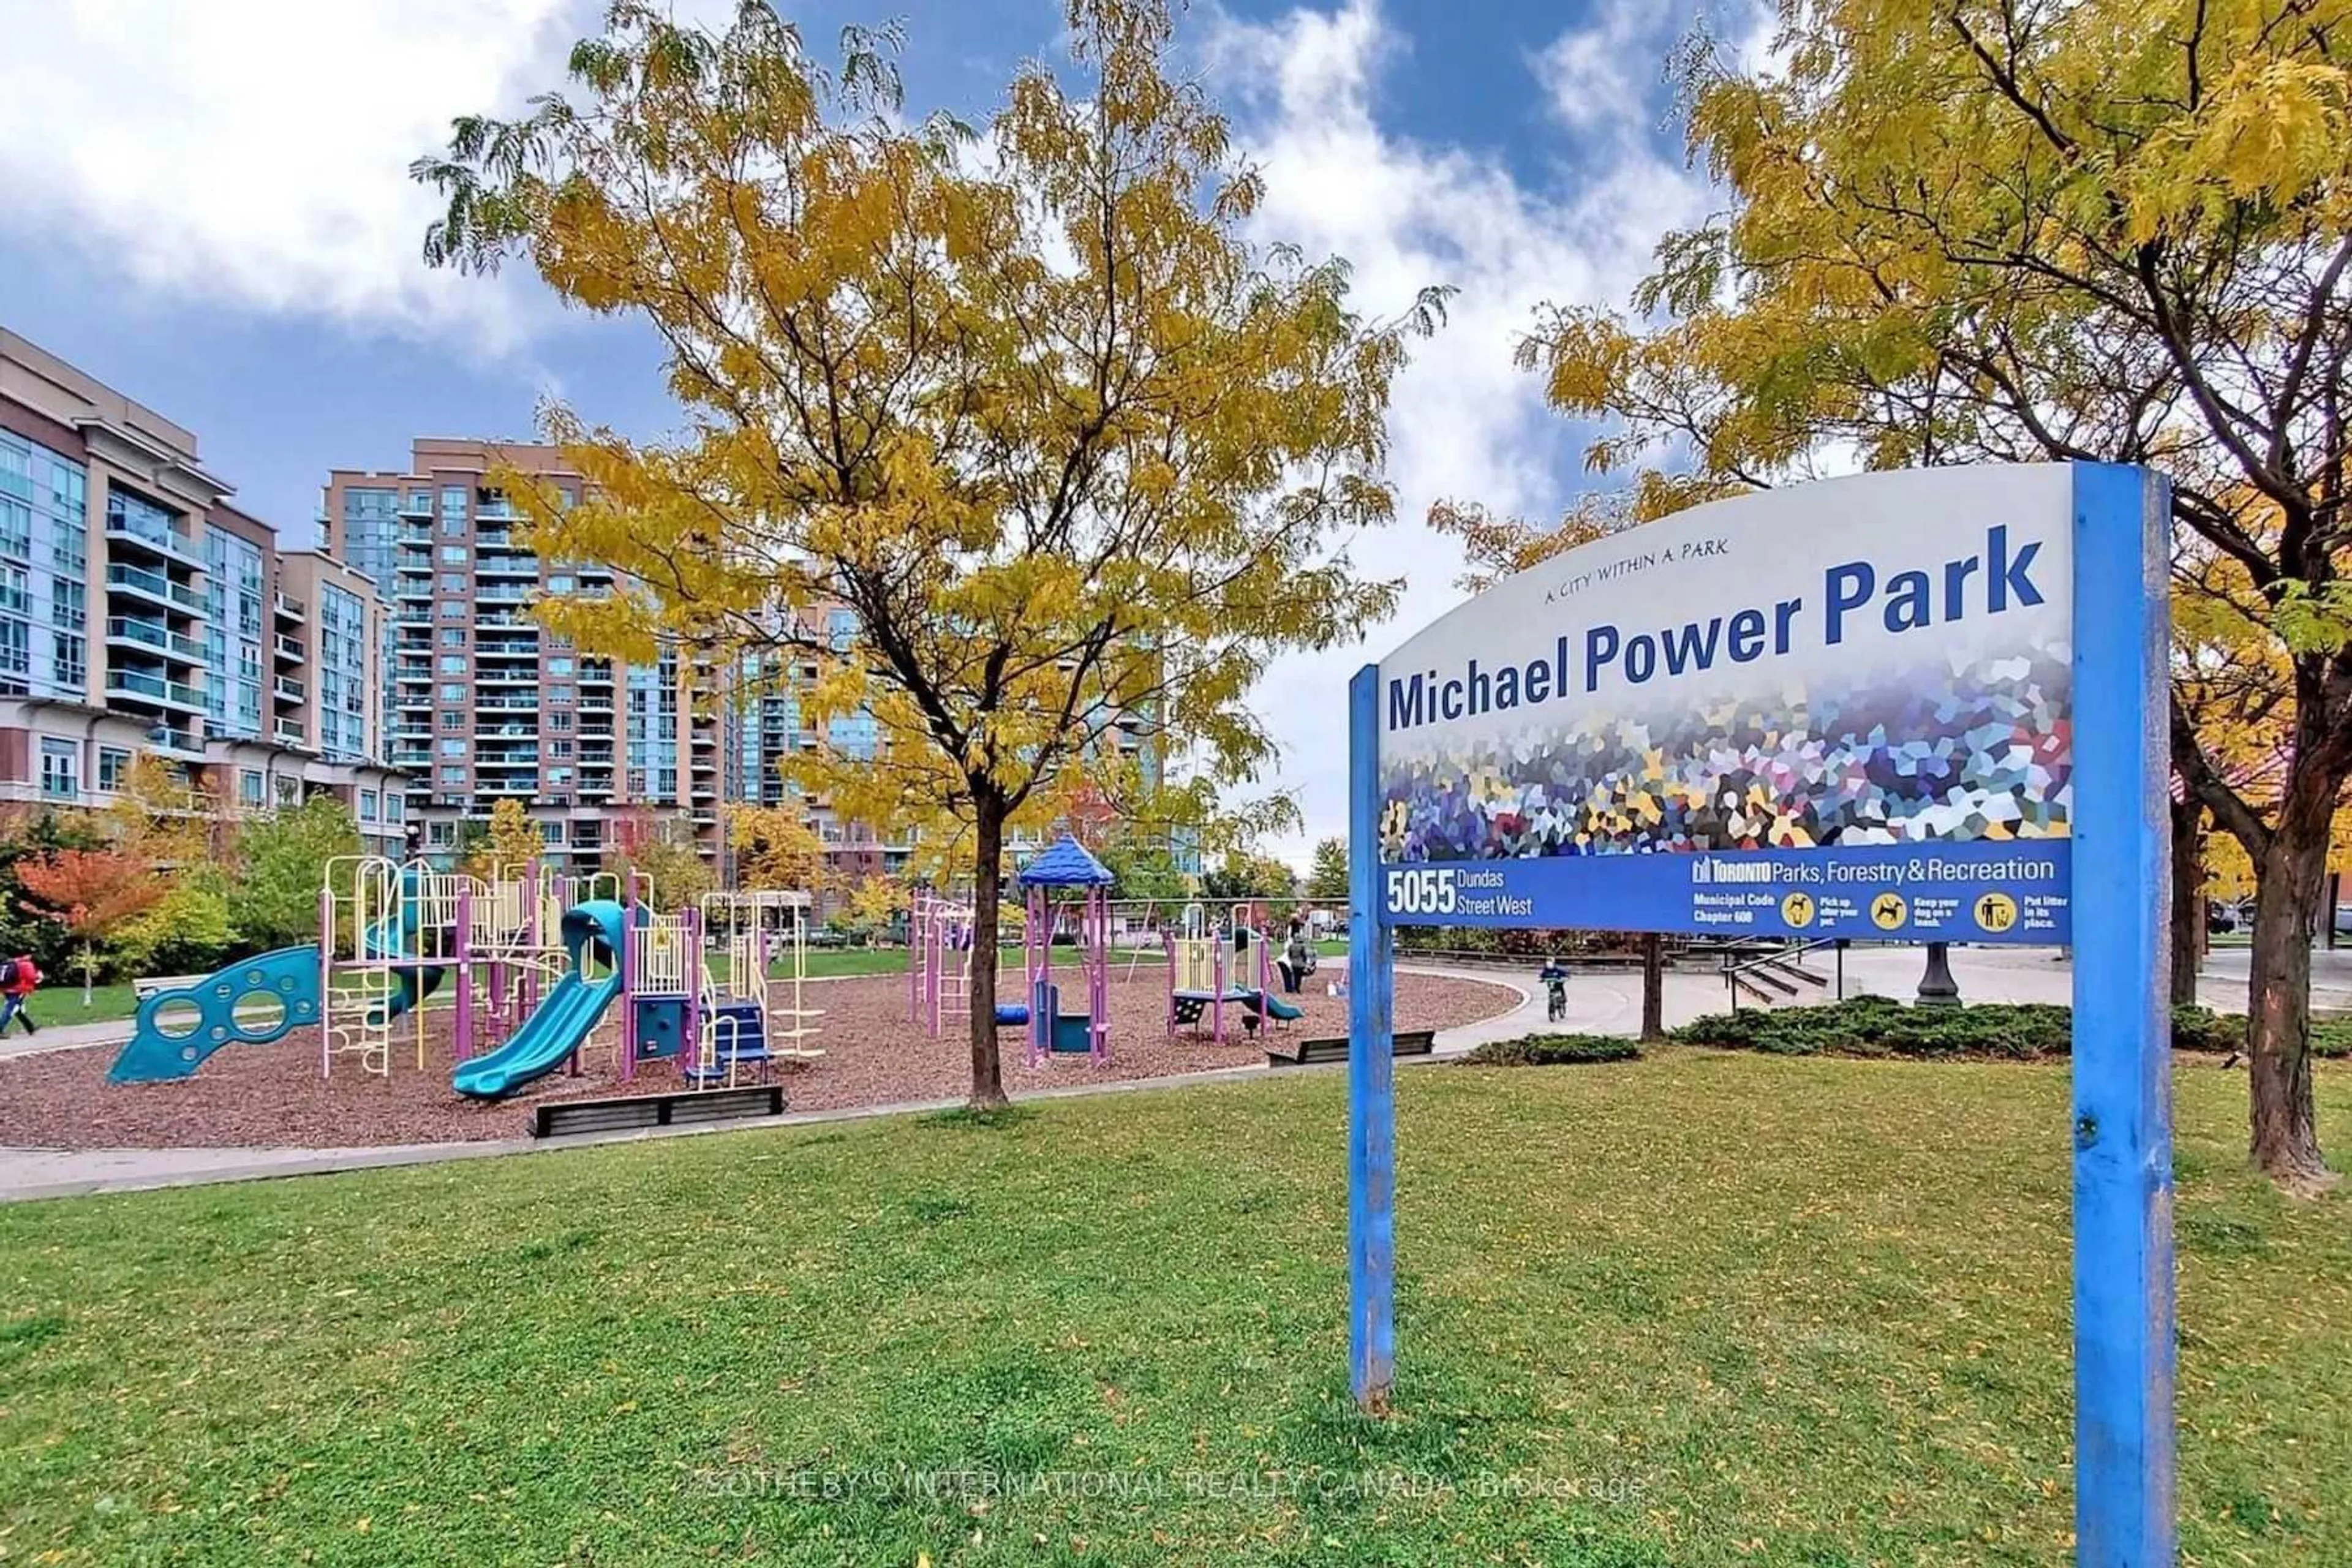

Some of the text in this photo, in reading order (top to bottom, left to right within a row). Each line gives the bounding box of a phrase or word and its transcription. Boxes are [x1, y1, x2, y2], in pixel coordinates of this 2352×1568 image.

[1545, 537, 1732, 605] A CITY WITHIN A PARK
[1389, 524, 2045, 731] Michael Power Park
[1458, 869, 1504, 888] Dundas
[1713, 856, 2054, 886] TORONTO Parks, Forestry & Recreation
[1387, 869, 1457, 914] 5055
[1458, 894, 1532, 916] Street West
[1694, 893, 1775, 908] Municipal Code
[1820, 897, 1838, 907] Pick
[1914, 898, 1959, 908] Keep your
[2024, 895, 2068, 906] Put litter
[1694, 910, 1732, 925] Chapter
[1914, 908, 1931, 918] dog
[2024, 907, 2049, 918] in its
[2024, 919, 2057, 930] place.
